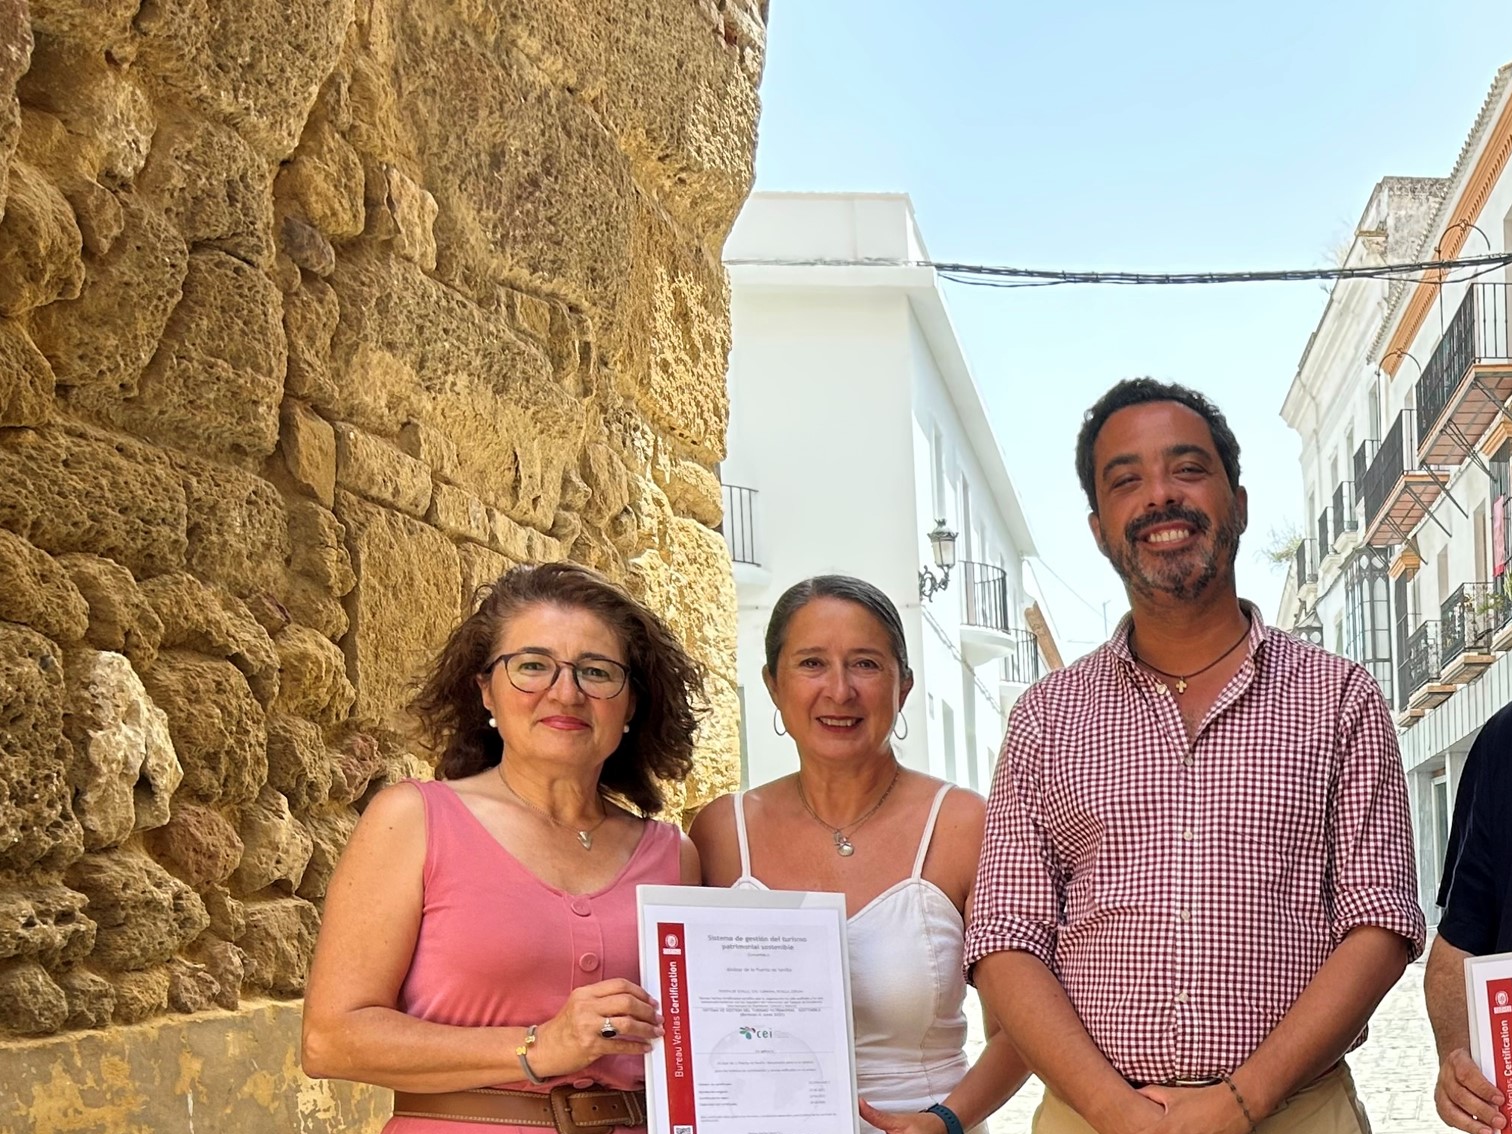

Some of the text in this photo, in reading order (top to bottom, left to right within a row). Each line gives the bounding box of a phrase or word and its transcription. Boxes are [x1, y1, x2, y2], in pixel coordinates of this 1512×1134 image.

[707, 934, 733, 942] Sistema
[745, 935, 769, 943] gestión
[722, 943, 760, 951] patrimonial
[668, 961, 680, 1014] Certification
[672, 1015, 682, 1046] Veritas
[756, 1028, 773, 1039] cei
[674, 1047, 684, 1078] Bureau
[1501, 1020, 1512, 1076] Certification
